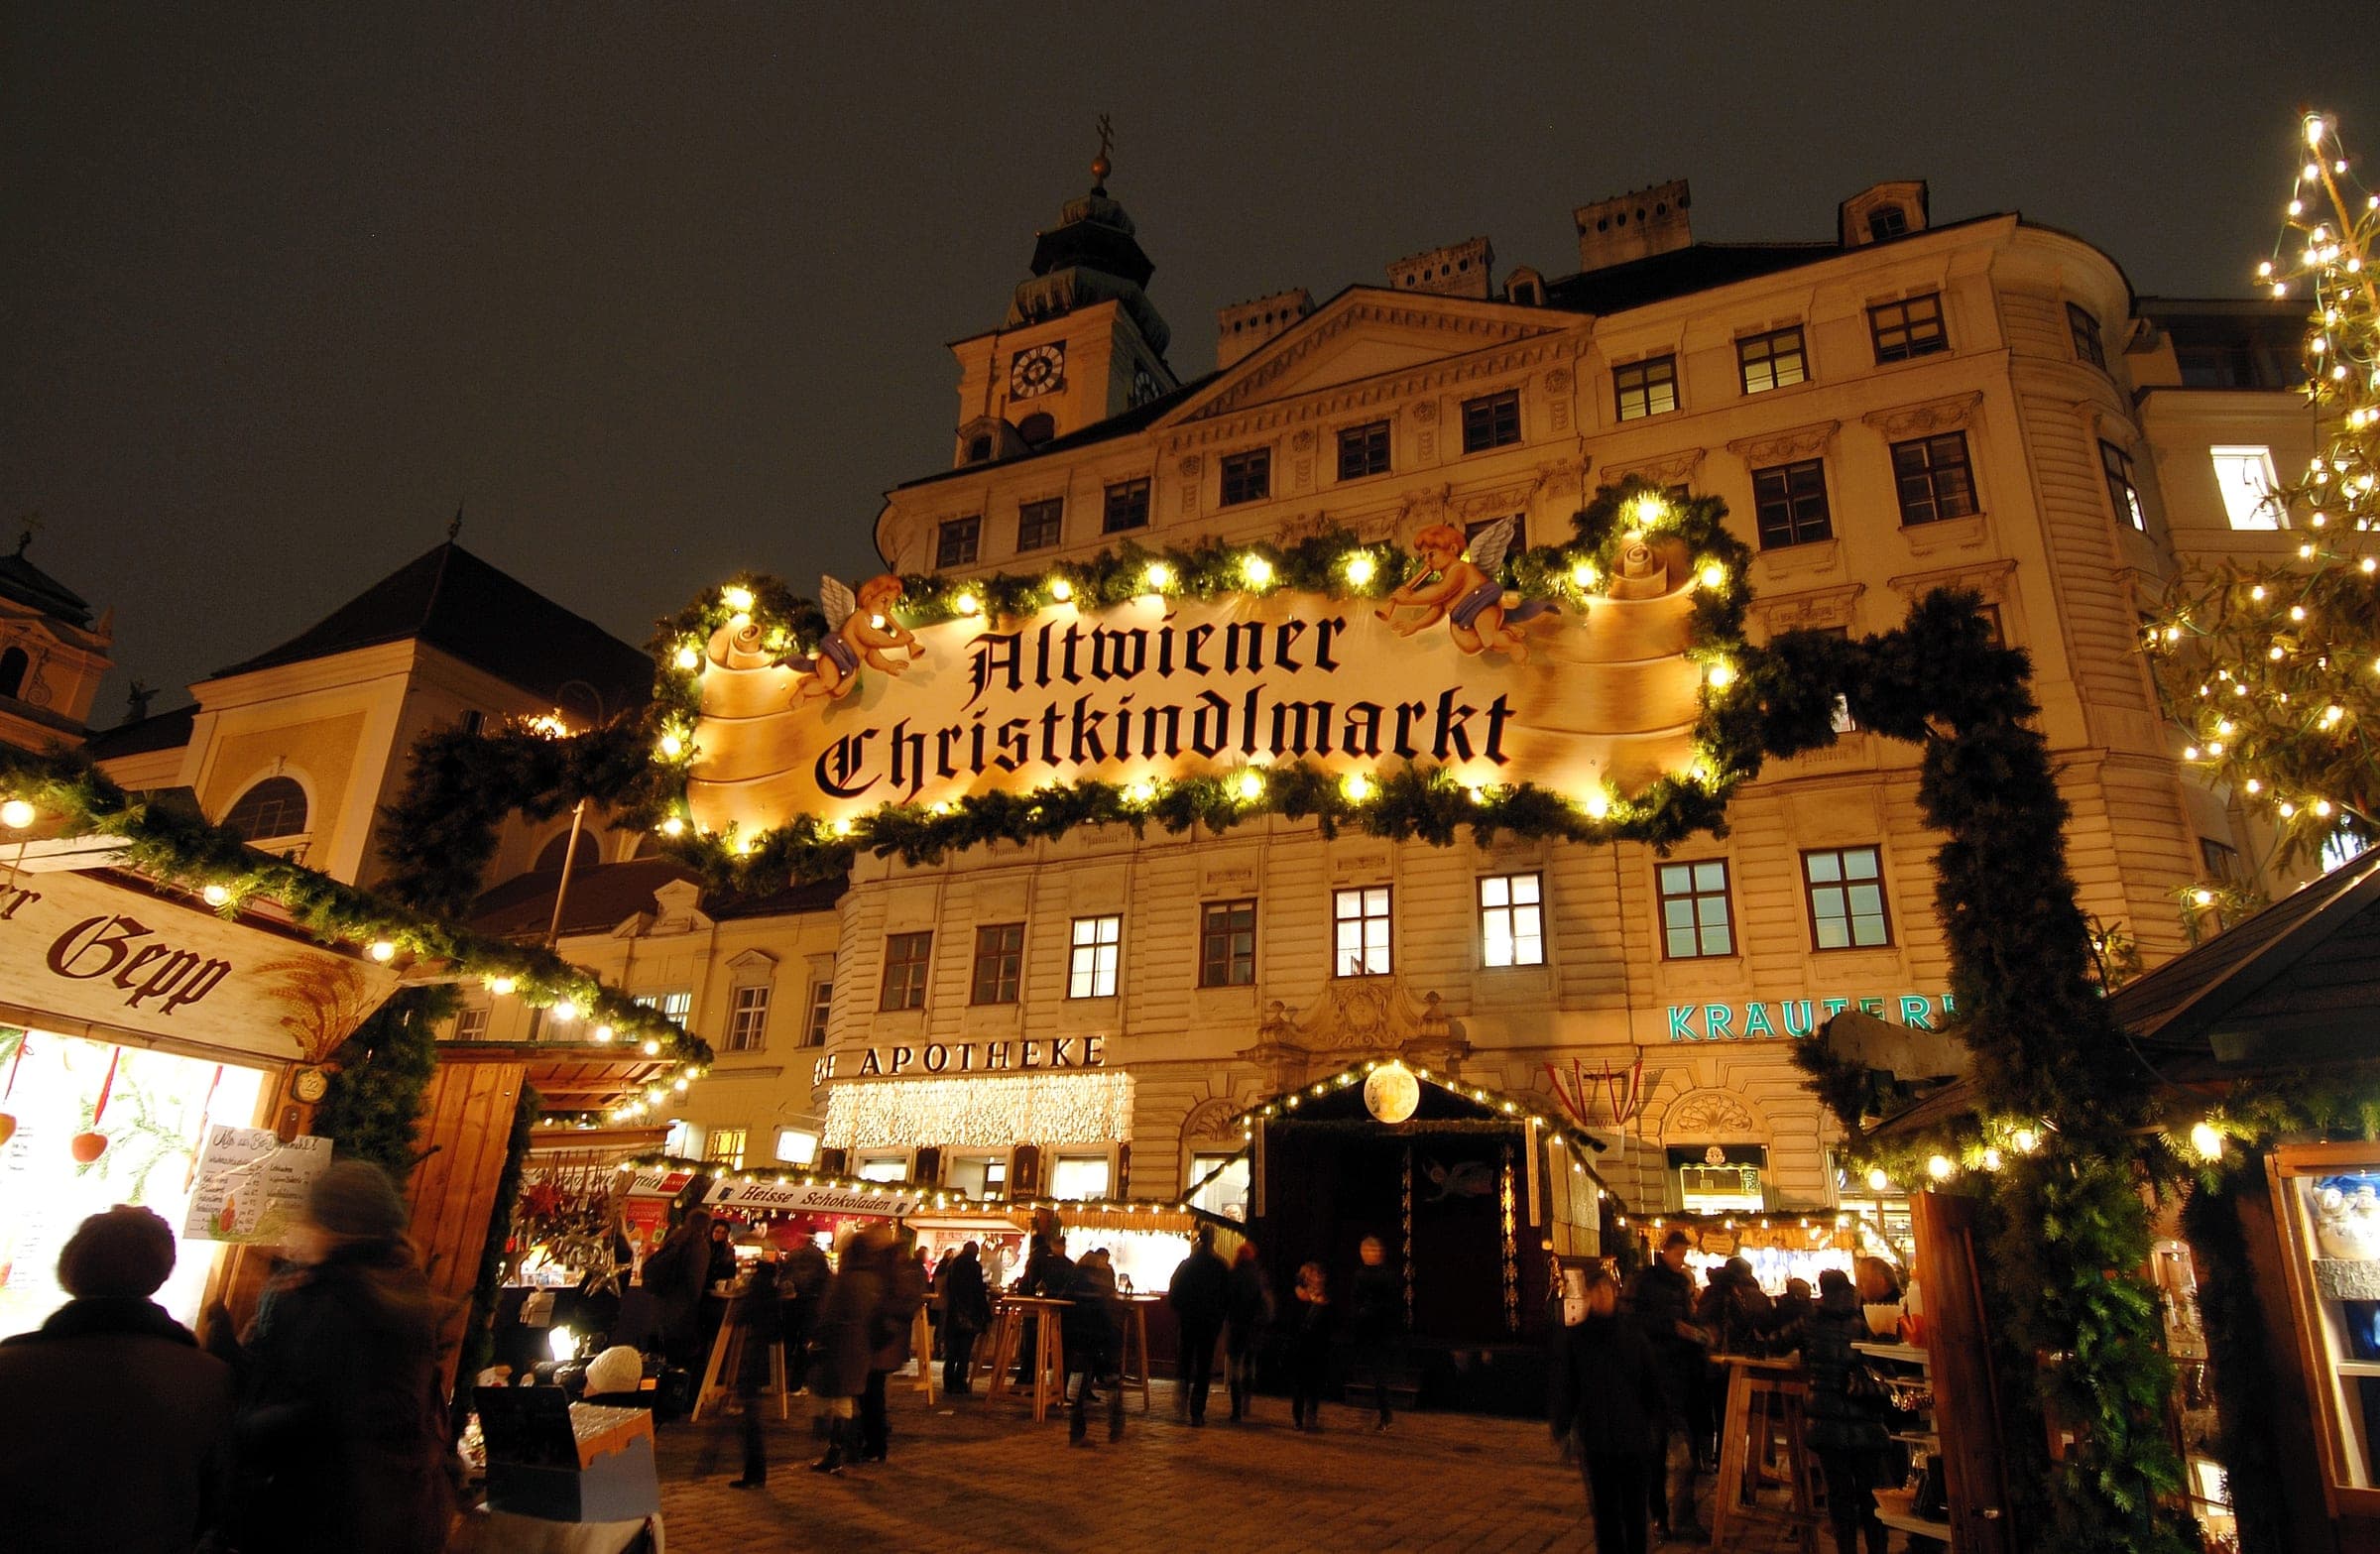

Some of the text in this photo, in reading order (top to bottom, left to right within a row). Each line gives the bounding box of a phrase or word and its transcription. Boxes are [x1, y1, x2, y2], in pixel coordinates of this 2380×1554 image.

[960, 612, 1347, 710] Altwiener
[813, 682, 1517, 804] Christkindlmarkt
[860, 1036, 1105, 1075] APOTHEKE
[739, 1185, 892, 1211] Heisse Schokoladen
